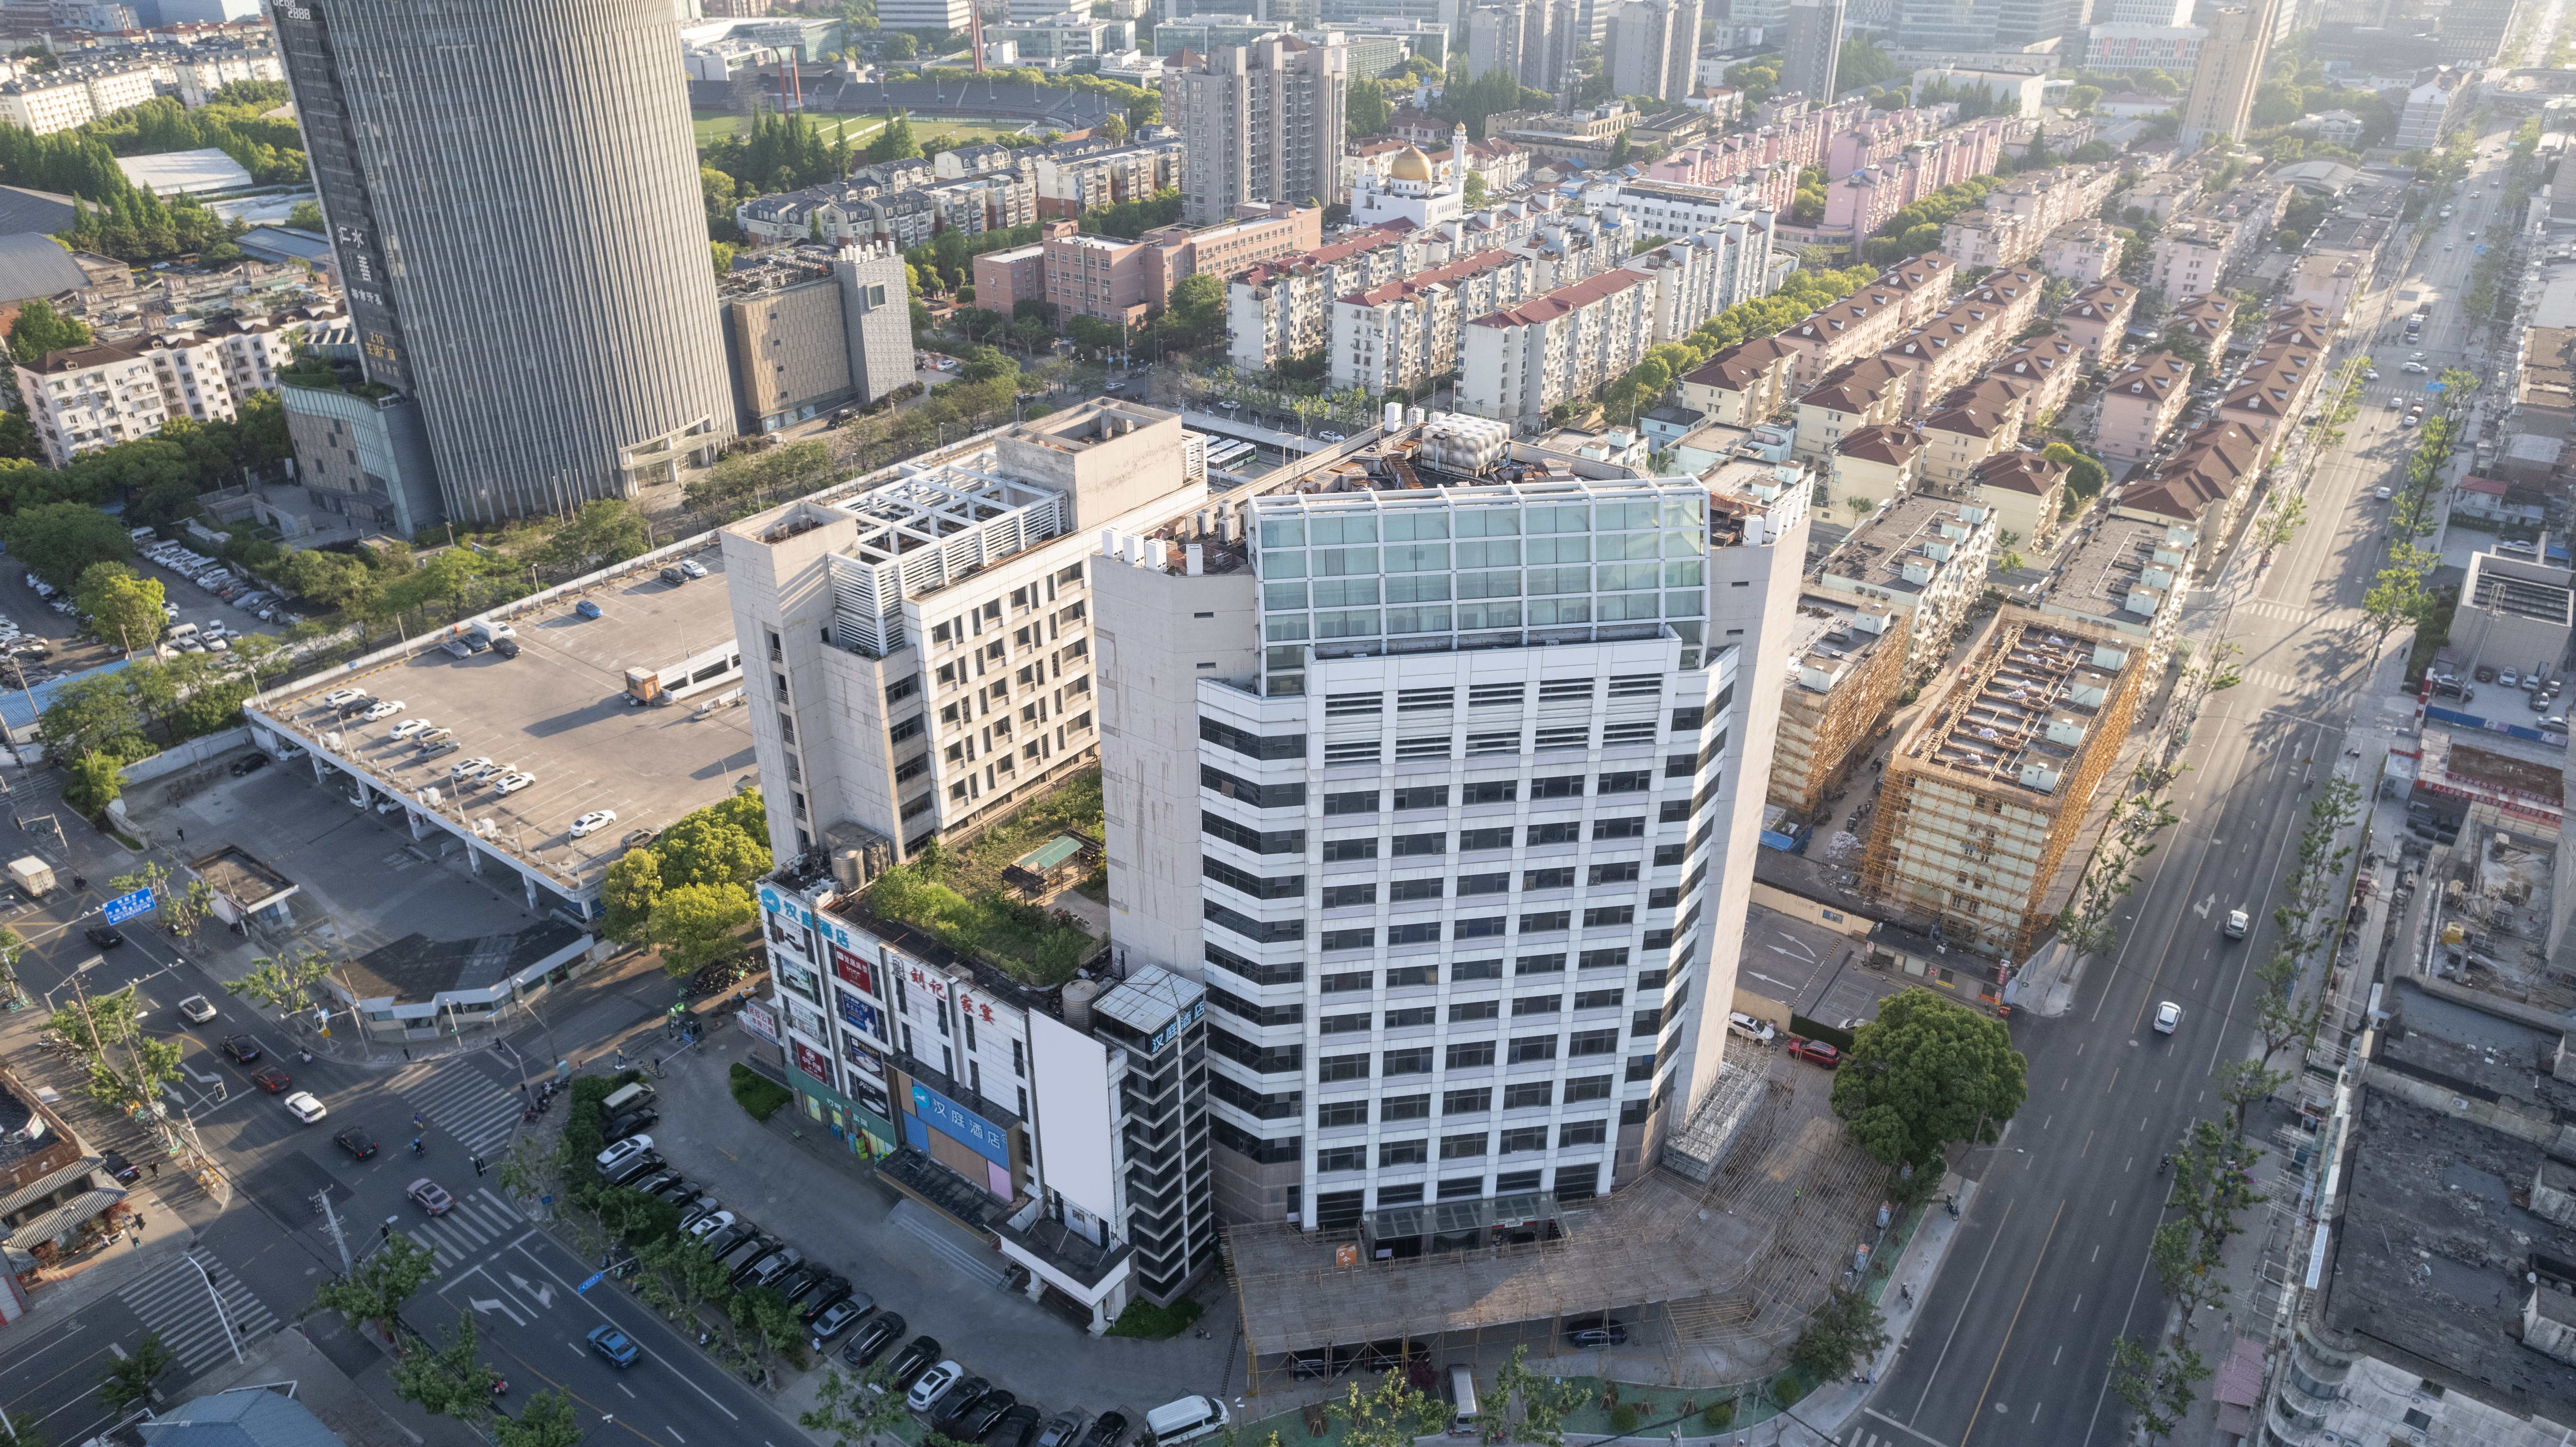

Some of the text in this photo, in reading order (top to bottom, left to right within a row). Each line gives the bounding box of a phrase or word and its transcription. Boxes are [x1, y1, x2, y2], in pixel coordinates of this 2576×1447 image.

[288, 8, 310, 20] 2888
[365, 342, 396, 361] 生活广场
[784, 900, 849, 949] 汉庭酒店
[1152, 1000, 1204, 1052] 汉庭酒店
[933, 1098, 1000, 1149] 汉庭酒店
